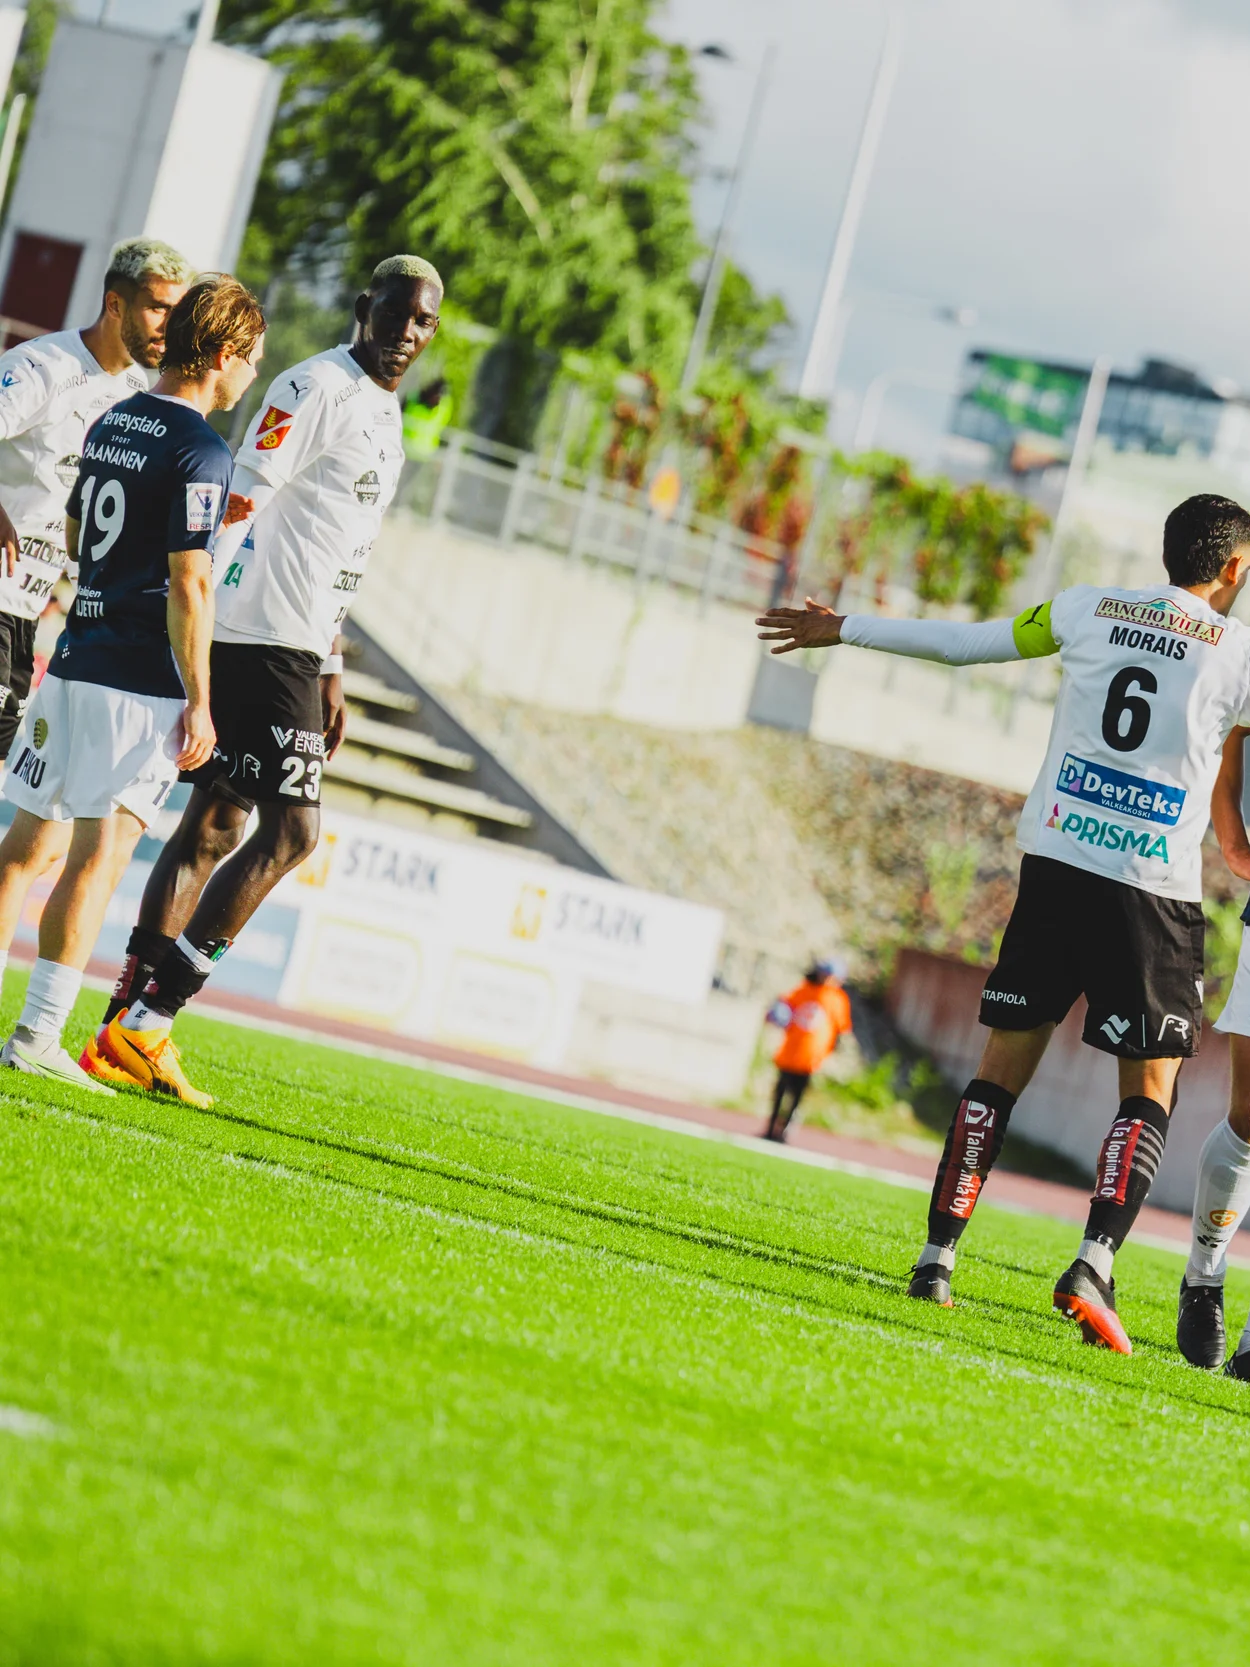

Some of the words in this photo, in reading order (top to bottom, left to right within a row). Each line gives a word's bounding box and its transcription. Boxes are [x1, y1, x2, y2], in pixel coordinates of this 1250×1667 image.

[102, 409, 167, 438] Terveystalo
[111, 434, 132, 446] SPORT
[84, 441, 148, 473] PAANANEN
[78, 475, 125, 562] 19
[1100, 599, 1165, 626] PANCHO
[1168, 612, 1217, 640] VILLA
[1108, 626, 1188, 661] MORAIS
[1102, 666, 1158, 752] 6
[278, 756, 323, 801] 23
[1083, 774, 1181, 818] DevTeks
[1101, 798, 1151, 820] VALKEAKOSKI
[1061, 812, 1170, 864] PRISMA
[343, 836, 442, 895] STARK
[555, 891, 648, 949] STARK
[1103, 1126, 1132, 1185] Talopinta
[1100, 1186, 1117, 1199] O
